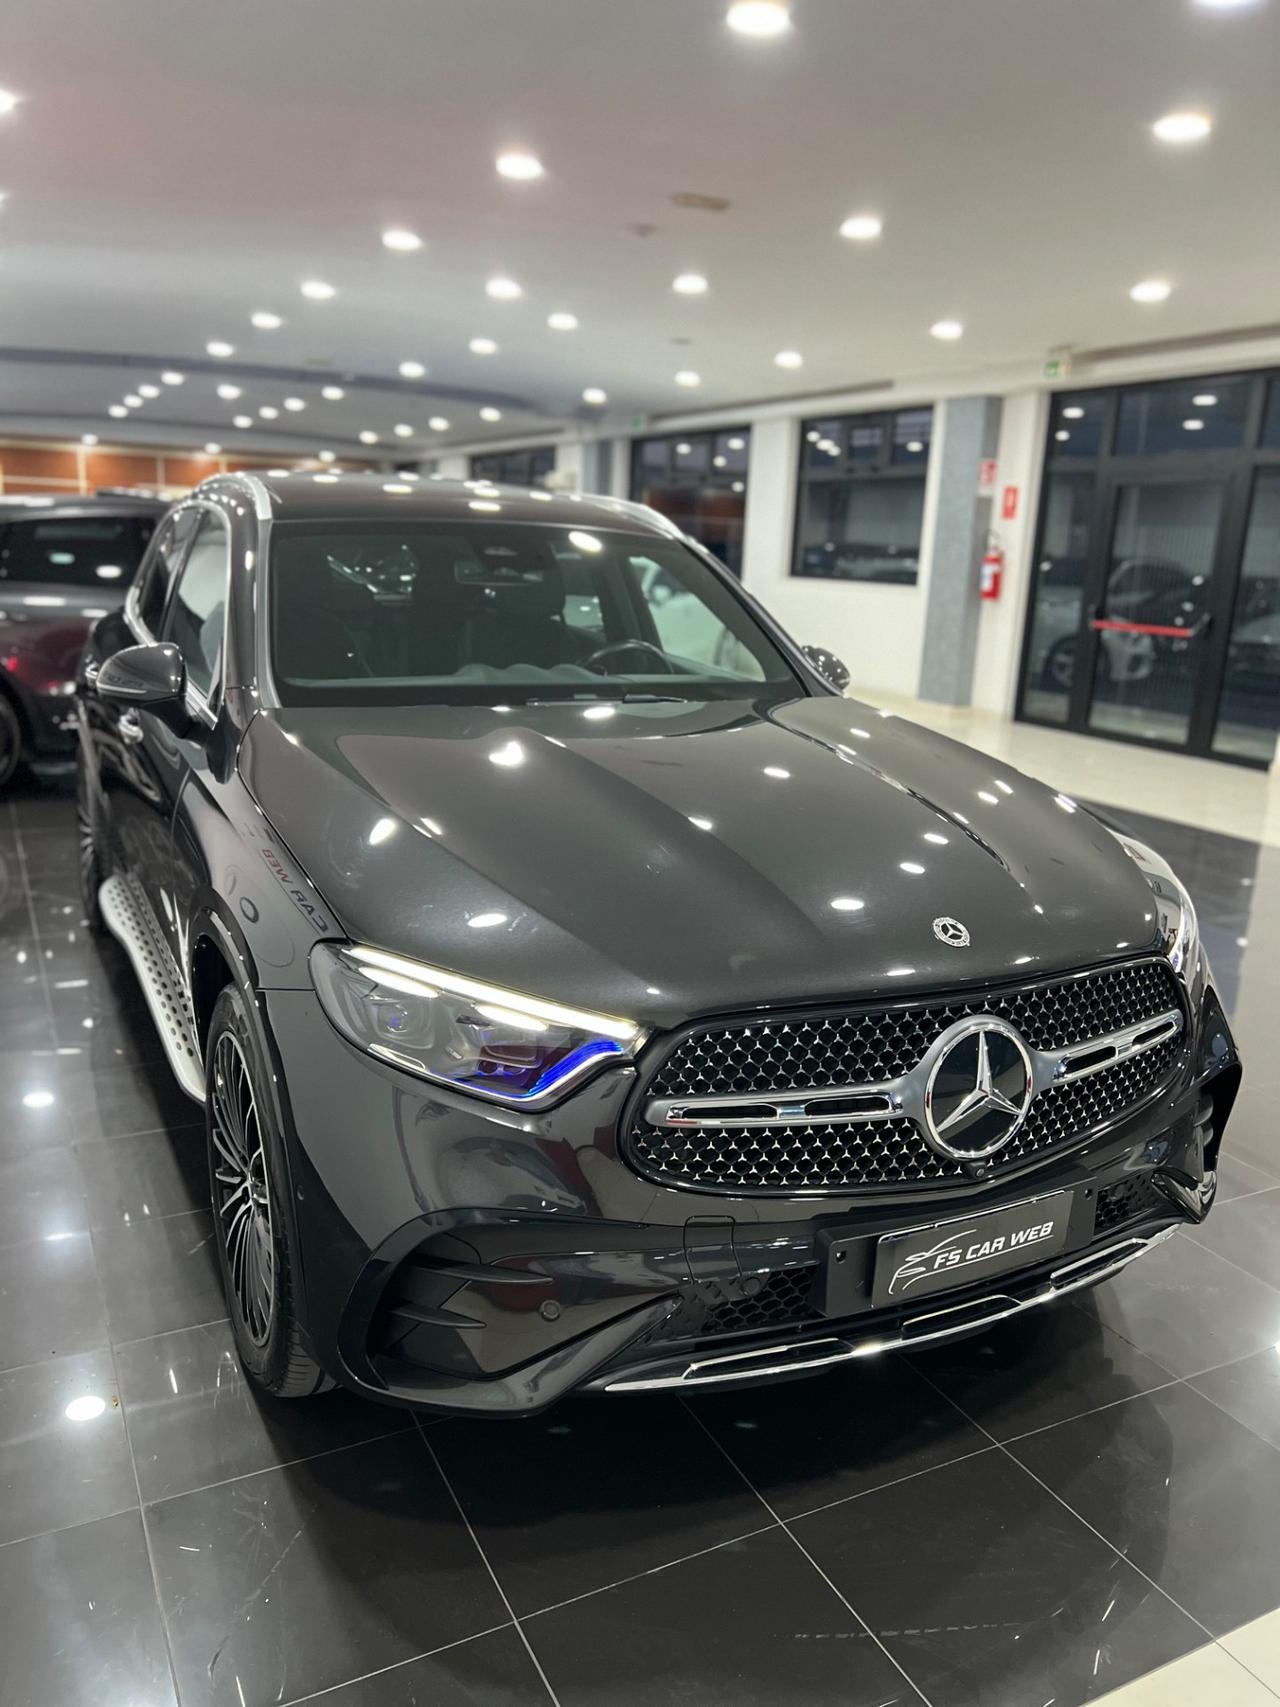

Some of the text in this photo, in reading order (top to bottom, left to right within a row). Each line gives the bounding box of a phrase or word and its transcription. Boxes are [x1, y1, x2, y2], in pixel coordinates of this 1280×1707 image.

[933, 1221, 1054, 1269] FS CAR WEB
